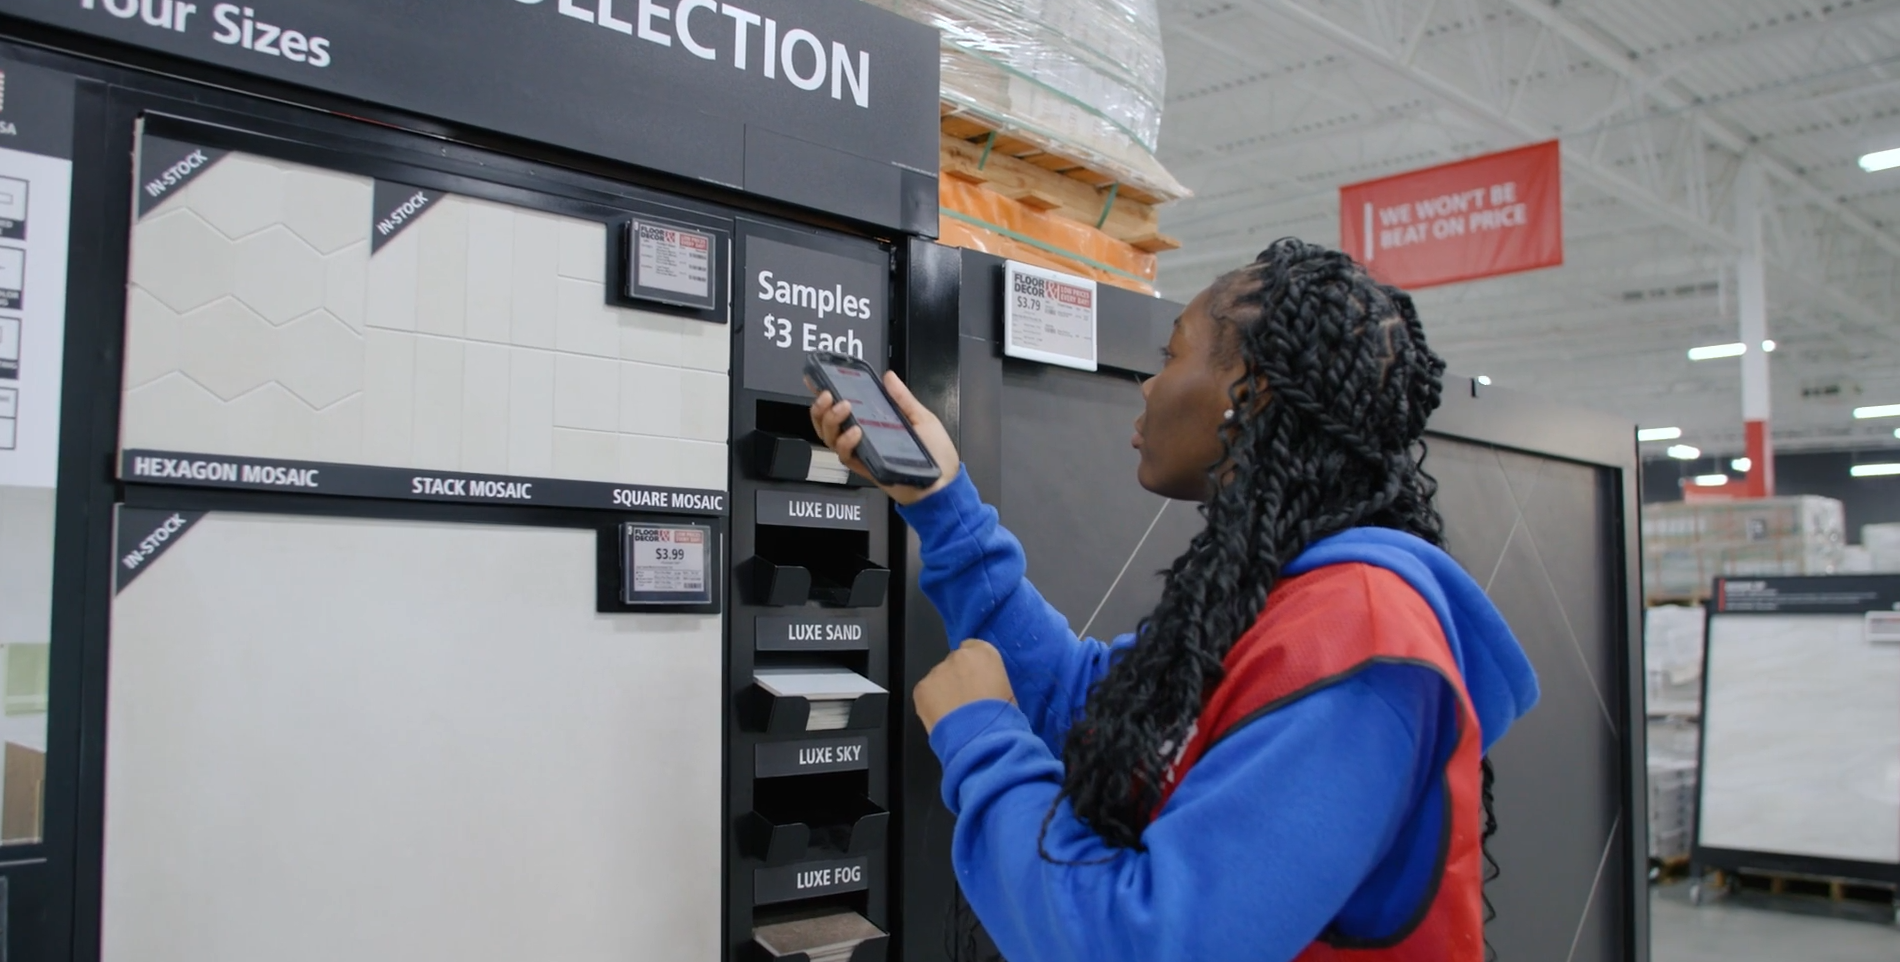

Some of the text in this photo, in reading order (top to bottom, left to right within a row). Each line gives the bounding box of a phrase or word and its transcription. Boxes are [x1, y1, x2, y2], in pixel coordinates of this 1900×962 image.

[212, 3, 331, 67] Sizes
[145, 149, 208, 197] IN-STOCK
[375, 191, 429, 235] IN-STOCK
[1379, 182, 1515, 225] WE WON'T BE
[641, 227, 664, 236] FLOOR
[641, 232, 665, 241] DECOR
[1380, 204, 1525, 249] BEAT ON PRICE
[1014, 273, 1044, 289] FLOOR
[1014, 283, 1045, 298] DECOR
[758, 270, 871, 319] Samples
[1017, 296, 1041, 311] $3.79
[763, 313, 863, 361] $3 Each
[134, 457, 319, 487] HEXAGON MOSAIC
[412, 476, 532, 499] STACK MOSAIC
[613, 489, 723, 511] SQUARE MOSAIC
[789, 500, 861, 521] LUXE DUNE
[122, 513, 187, 569] IN-STOCK
[655, 547, 684, 560] $3.99
[788, 624, 862, 641] LUXE SAND
[799, 745, 861, 765] LUXE SKY
[797, 866, 861, 889] LUXE FOG
